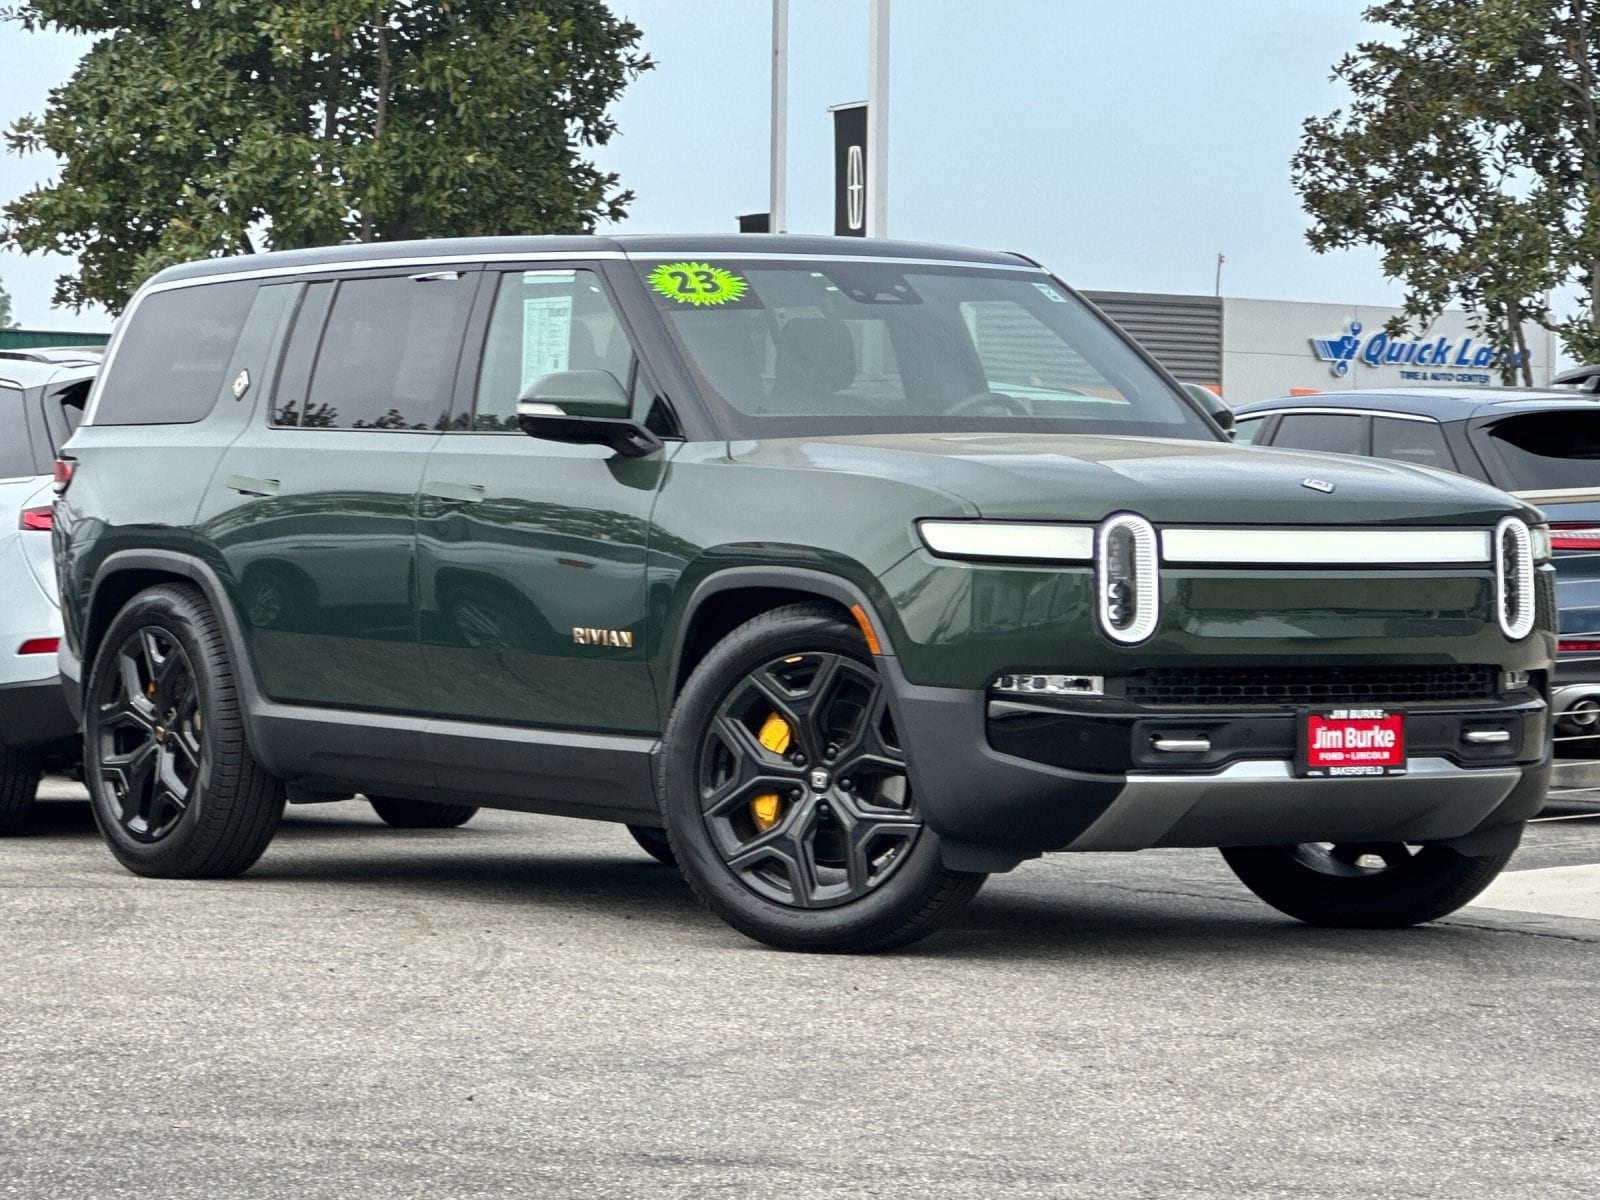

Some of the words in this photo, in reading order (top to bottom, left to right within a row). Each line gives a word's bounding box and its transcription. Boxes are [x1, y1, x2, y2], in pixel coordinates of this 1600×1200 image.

[668, 271, 720, 294] 23
[1362, 332, 1450, 367] Quick
[1400, 370, 1420, 380] TIRE
[1430, 372, 1455, 382] AUTO
[1456, 373, 1491, 385] CENTER
[573, 627, 633, 648] RIVIAN
[1330, 709, 1348, 719] JIM
[1349, 709, 1384, 719] BURKE
[1312, 726, 1343, 749] Jim
[1344, 725, 1396, 748] Burke
[1319, 752, 1344, 760] FORD
[1350, 751, 1390, 760] LINCOLN
